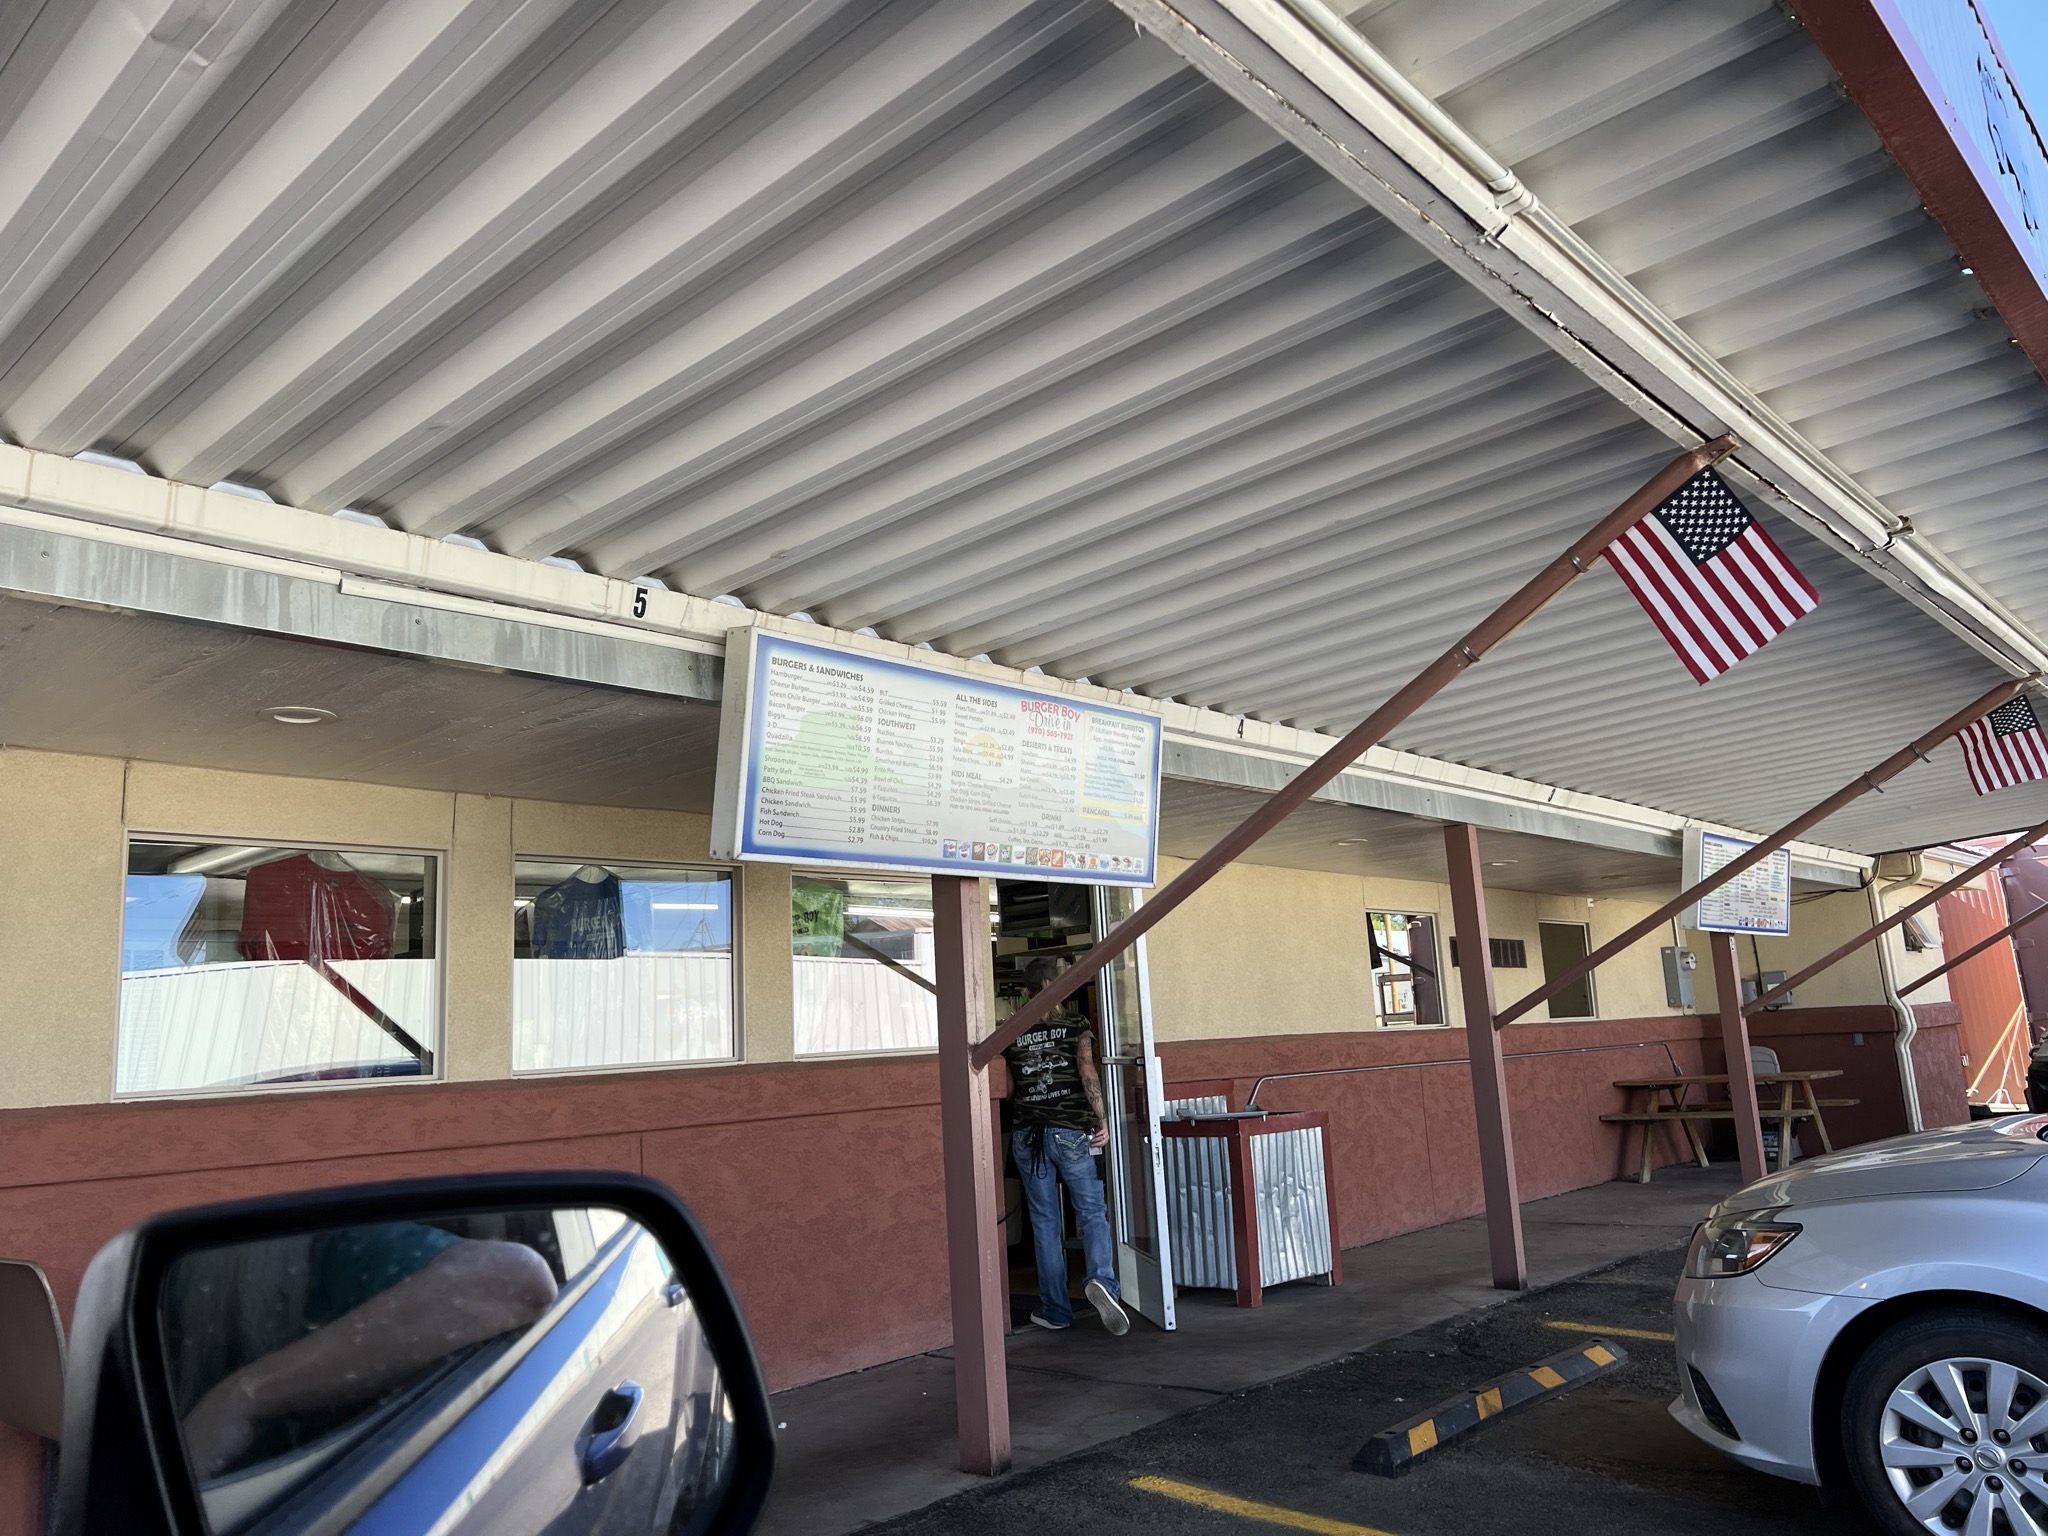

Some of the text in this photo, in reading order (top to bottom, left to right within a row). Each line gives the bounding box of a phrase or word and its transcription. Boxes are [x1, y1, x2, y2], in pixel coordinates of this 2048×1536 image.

[633, 587, 648, 618] 5
[771, 669, 803, 681] Hamburger
[772, 657, 864, 682] BURGERS & SANDWICHES
[770, 680, 810, 694] Cheese Burger
[769, 690, 820, 705] Green Chile Burger
[933, 699, 947, 707] $5.59
[956, 694, 998, 708] ALL THE SIDES
[769, 700, 805, 712] Bacon Burger
[879, 699, 895, 707] Grilled
[896, 702, 913, 710] Cheese
[879, 708, 897, 716] Chicken
[1021, 701, 1080, 723] BURGER BOY
[878, 718, 916, 731] SOUTHWEST
[1030, 711, 1060, 729] Drive
[1092, 717, 1144, 733] BREAKFAST BURRITOS
[1028, 725, 1045, 737] (970)
[1238, 719, 1244, 739] 4
[766, 732, 793, 741] Quadzilla
[876, 747, 893, 755] Burrito
[896, 741, 912, 749] Nachos
[1022, 740, 1047, 750] DESSERTS
[1054, 746, 1072, 754] TREATS
[765, 755, 797, 765] Shroomster
[876, 757, 902, 766] Smothered
[764, 766, 779, 775] Patty
[780, 767, 792, 775] Melt
[952, 770, 964, 778] KIDS
[966, 772, 982, 780] MEAL
[763, 776, 867, 794] BBQ Sandwich $7.59
[762, 787, 866, 804] Chicken Fried Steak Sandwich $5.99
[761, 797, 866, 814] Chicken Sandwich $5.99
[872, 804, 901, 814] DINNERS
[1083, 807, 1110, 816] PANCAKES
[773, 809, 800, 817] Sandwich
[849, 816, 865, 824] $5.99
[1042, 813, 1061, 822] DRINKS
[771, 820, 783, 828] Dog
[849, 826, 865, 834] $2.89
[870, 824, 890, 832] Country
[773, 830, 785, 839] Dog
[804, 910, 819, 923] BOY
[1016, 1031, 1048, 1047] BURGER
[1051, 1028, 1067, 1040] BOY
